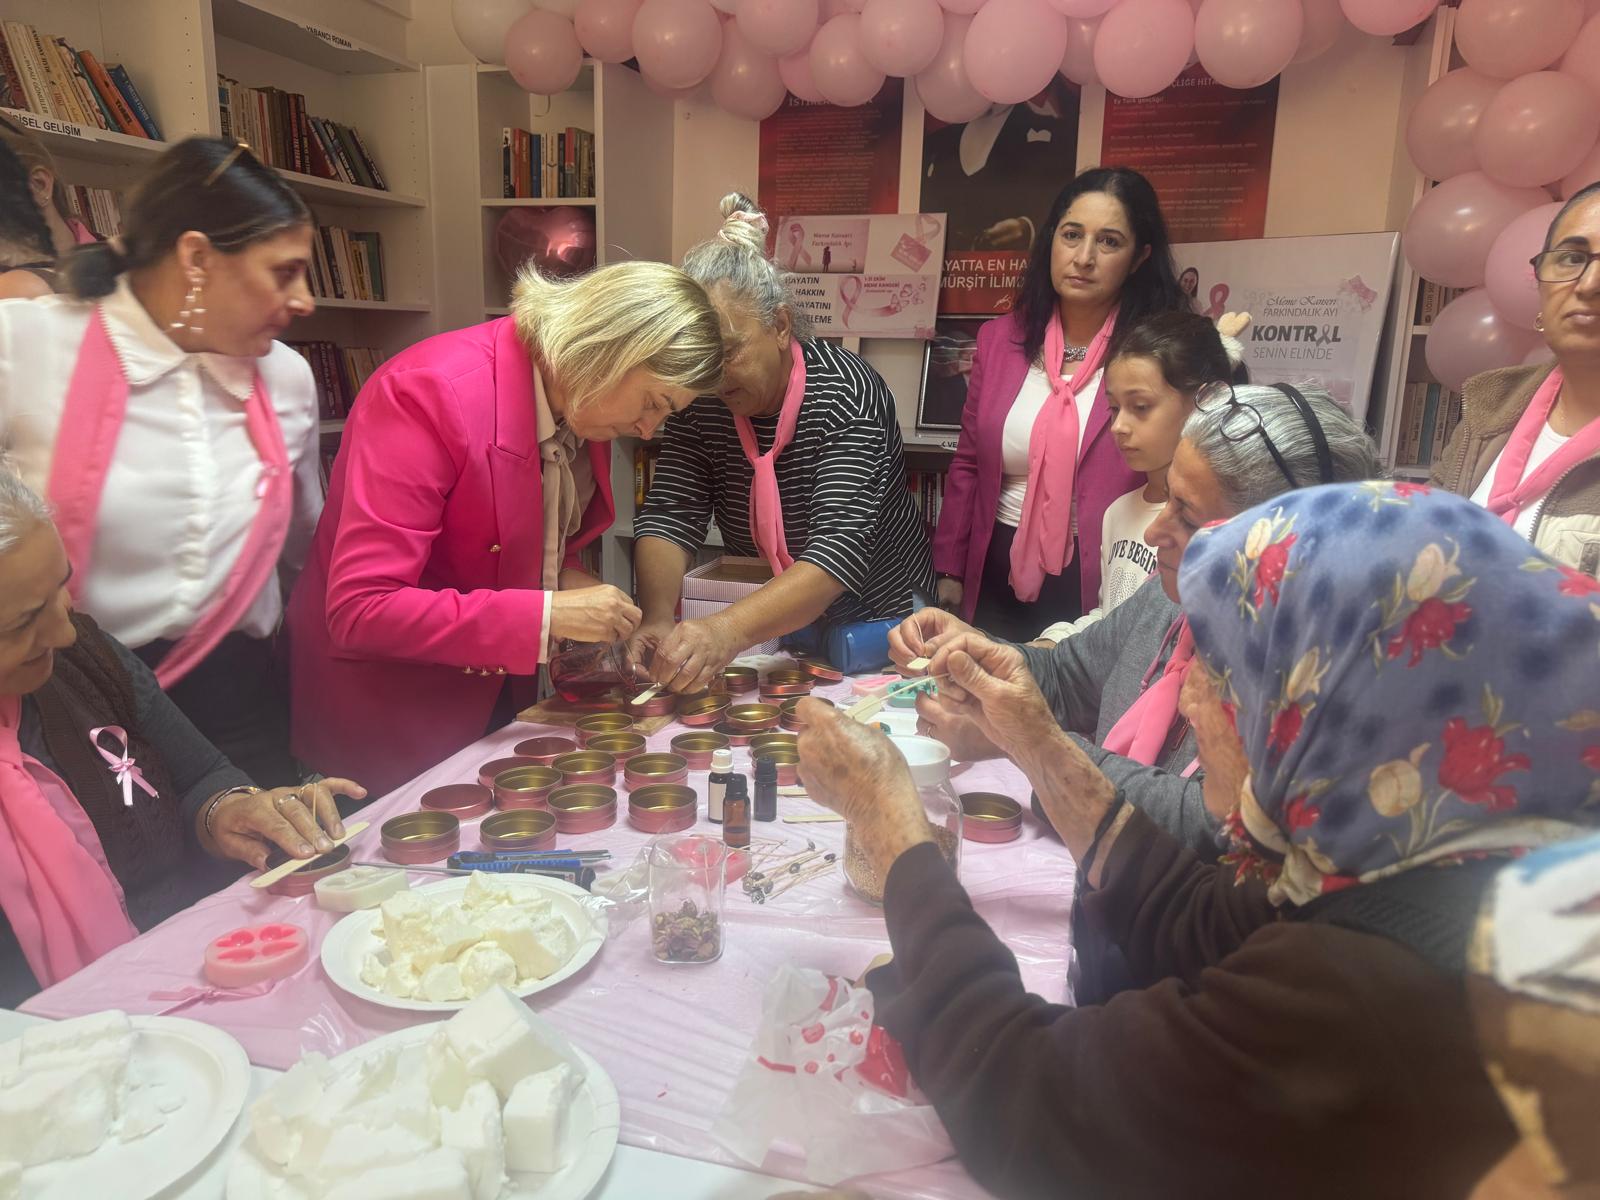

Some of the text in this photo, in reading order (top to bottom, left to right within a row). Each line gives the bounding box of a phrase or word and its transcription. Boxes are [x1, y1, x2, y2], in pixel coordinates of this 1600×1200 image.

[987, 259, 1006, 271] EN
[795, 288, 826, 297] HAKKIN
[1263, 307, 1338, 317] FARKINDALIK AYI
